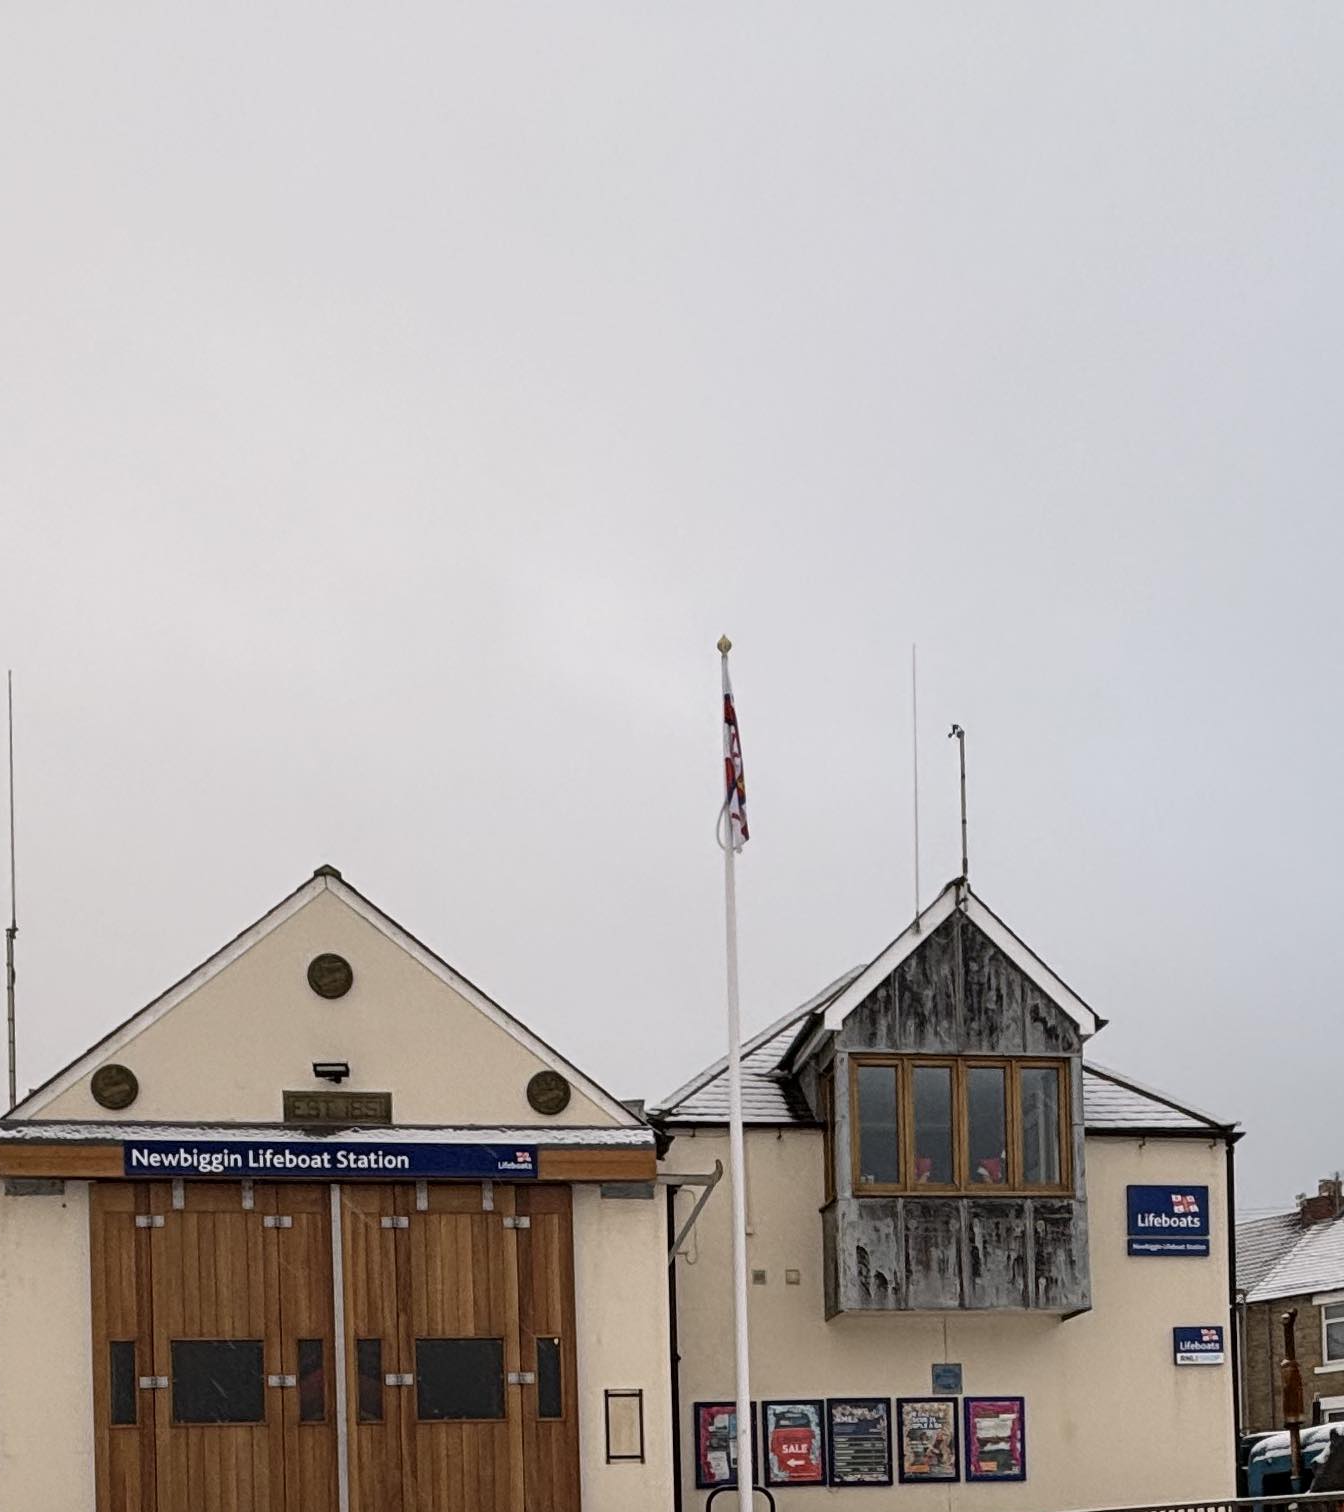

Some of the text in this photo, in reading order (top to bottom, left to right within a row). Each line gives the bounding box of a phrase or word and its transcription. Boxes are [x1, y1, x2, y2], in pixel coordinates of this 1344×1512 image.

[131, 1149, 410, 1172] Newbiggin Lifeboat Station
[1137, 1213, 1201, 1228] Lifeboats
[1179, 1341, 1220, 1350] Lifeboats
[782, 1443, 809, 1455] SALE
